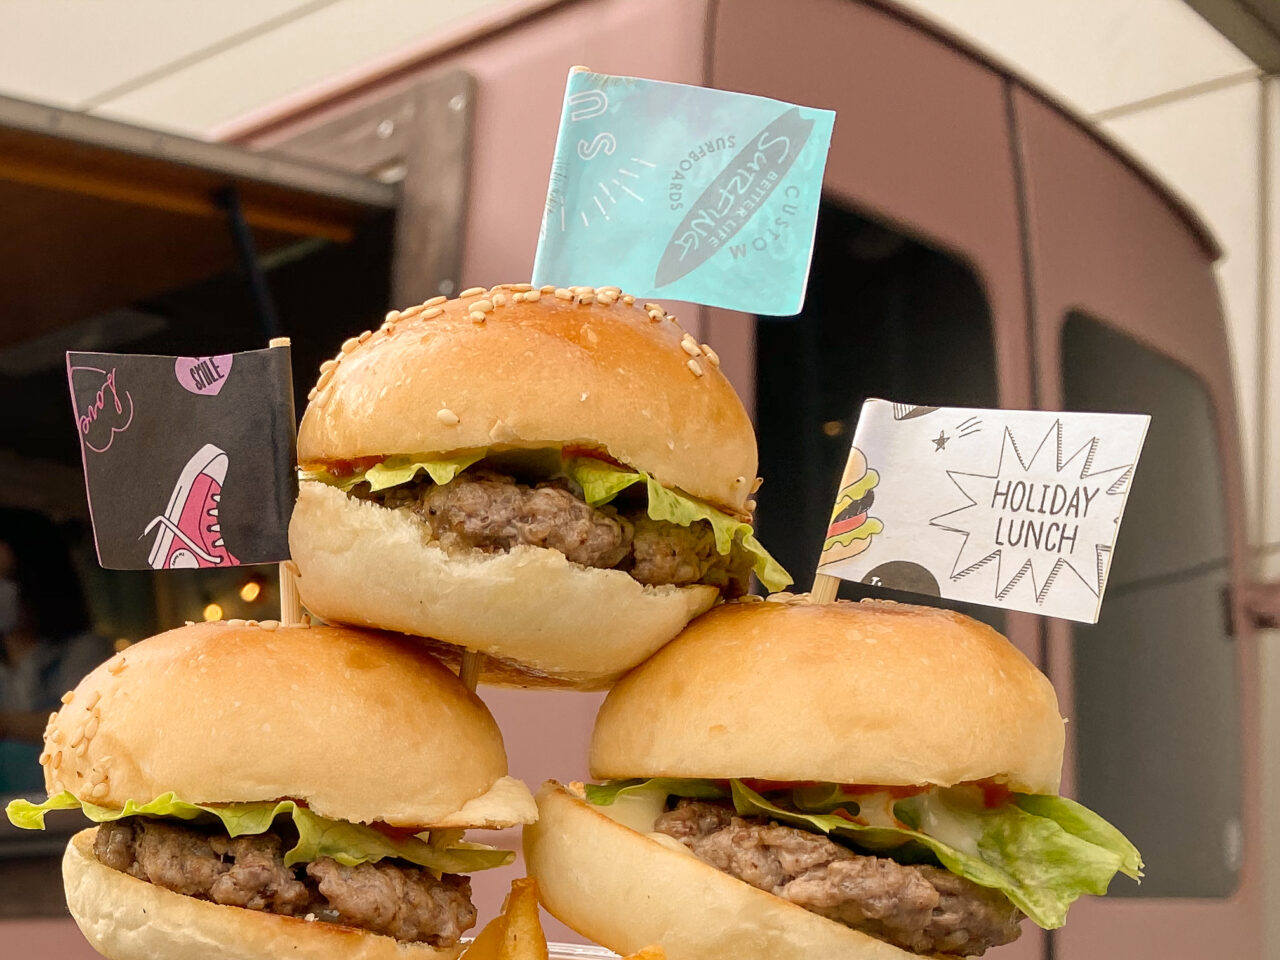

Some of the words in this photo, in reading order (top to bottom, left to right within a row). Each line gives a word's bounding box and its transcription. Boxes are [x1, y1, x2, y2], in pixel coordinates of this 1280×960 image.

[669, 135, 736, 212] SURFBOARDS
[736, 170, 778, 217] BETTER
[708, 215, 738, 248] LIFE
[728, 184, 801, 260] CUSTOM
[189, 357, 225, 391] SMILE
[991, 479, 1100, 519] HOLIDAY
[994, 516, 1080, 555] LUNCH
